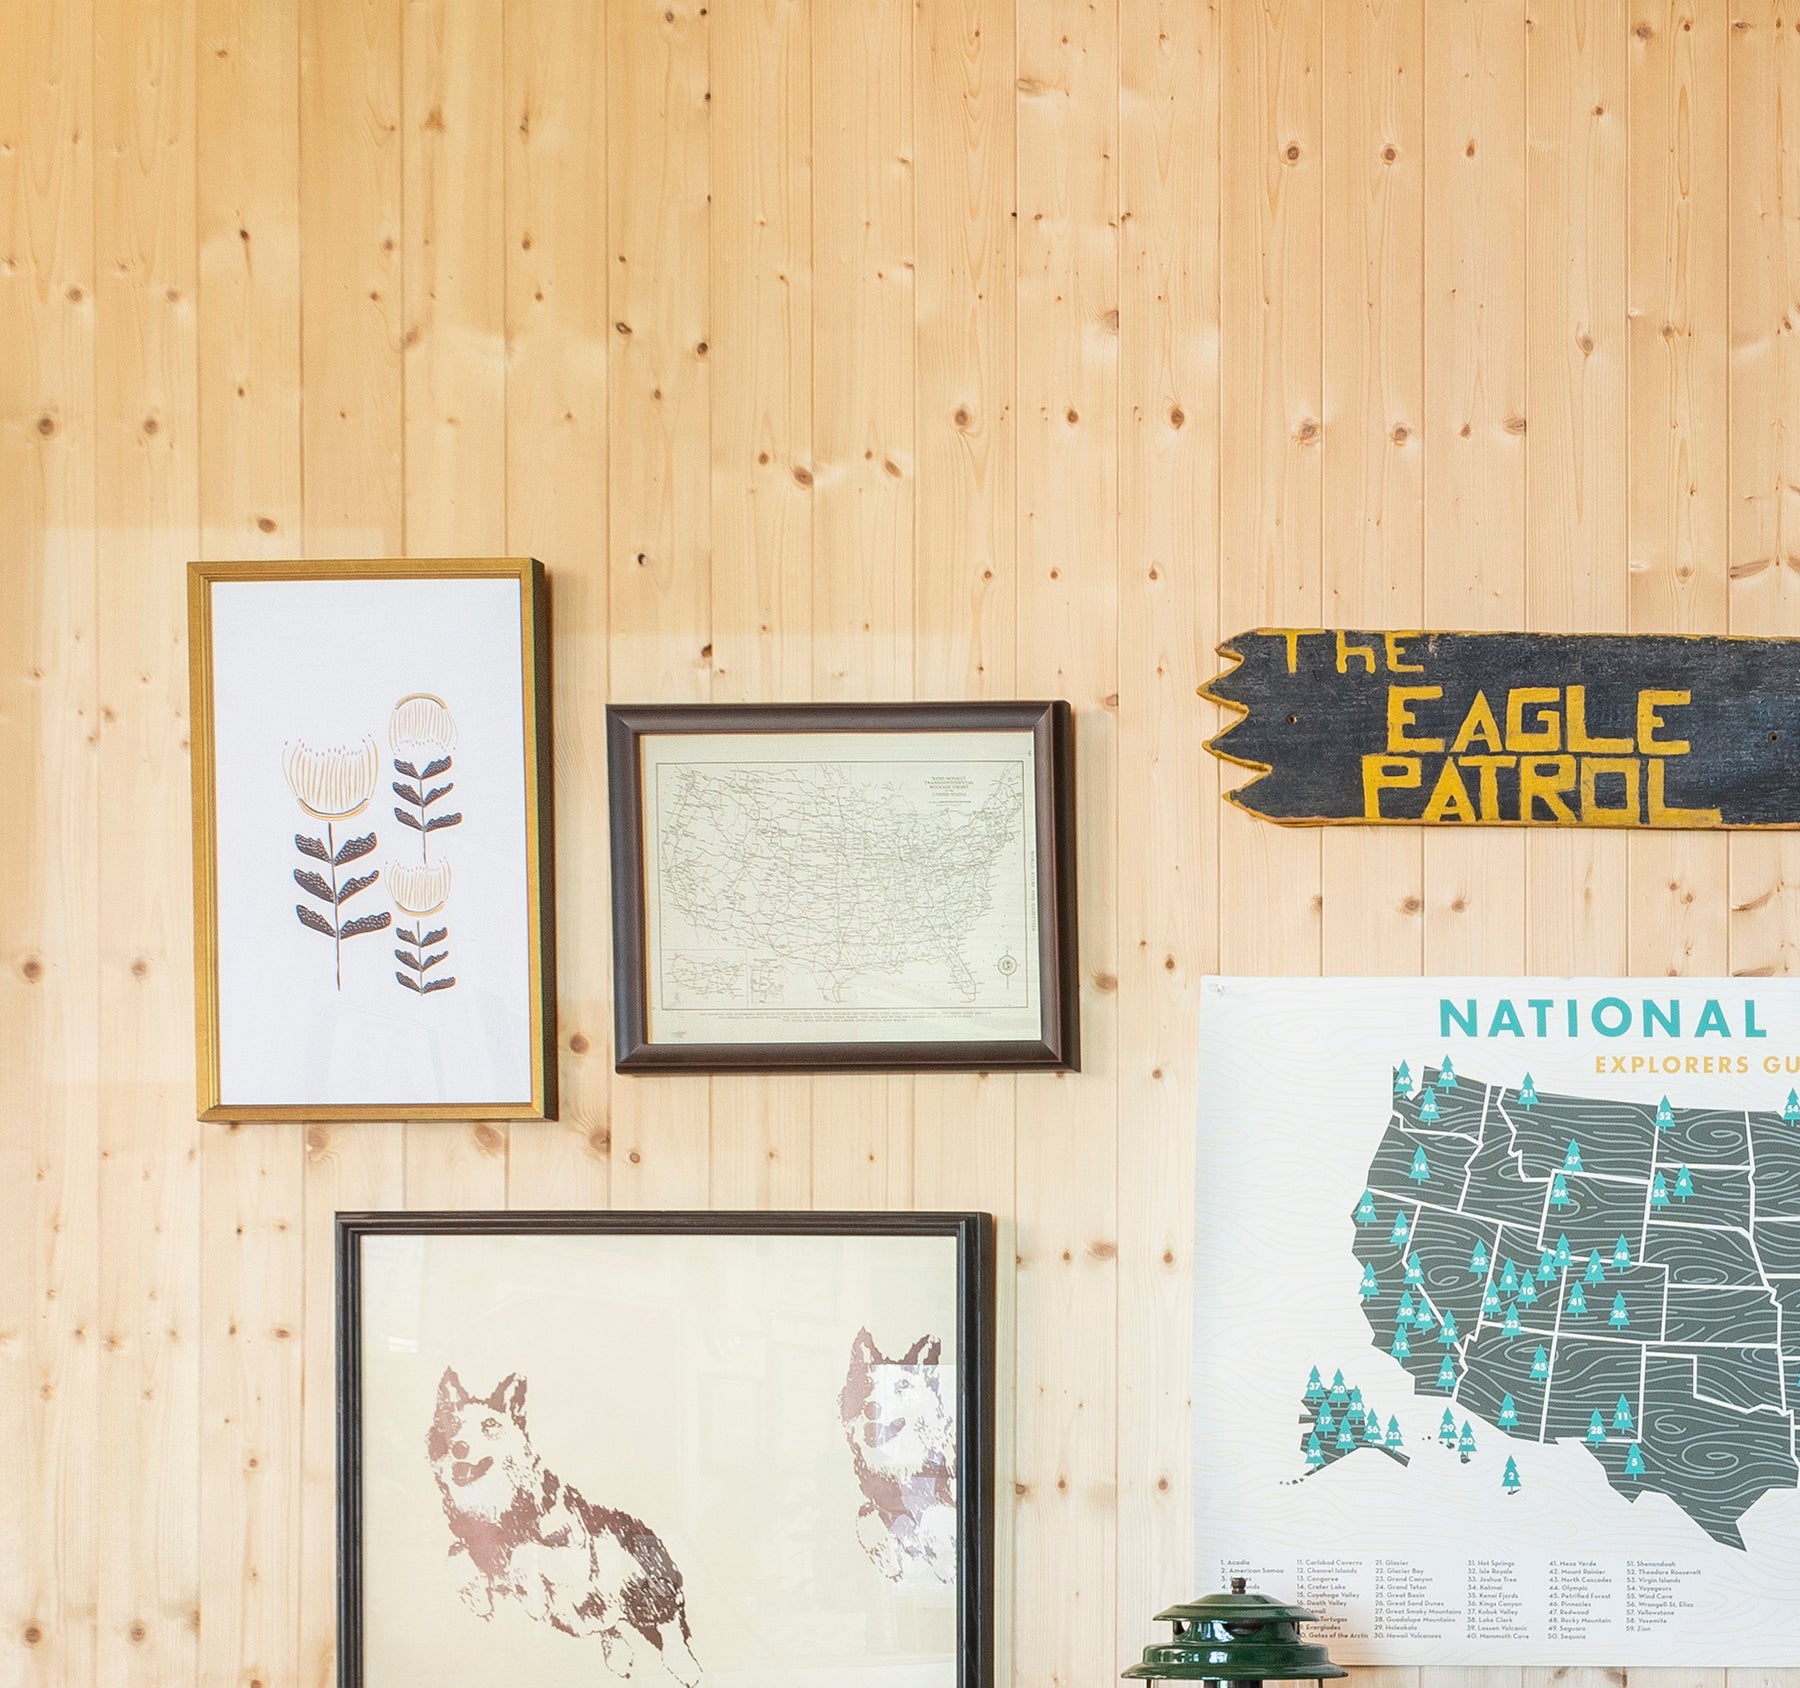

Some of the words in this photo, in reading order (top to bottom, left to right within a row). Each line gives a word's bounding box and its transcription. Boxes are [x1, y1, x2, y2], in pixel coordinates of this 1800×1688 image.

[1386, 685, 1692, 755] EAGLE
[1361, 754, 1722, 823] PATROL
[1439, 996, 1767, 1039] NATIONAL
[1595, 1055, 1750, 1075] EXPLORERS
[1398, 1076, 1410, 1086] 44
[1441, 1071, 1453, 1081] 43
[1522, 1088, 1533, 1098] 21
[1658, 1112, 1671, 1121] 52
